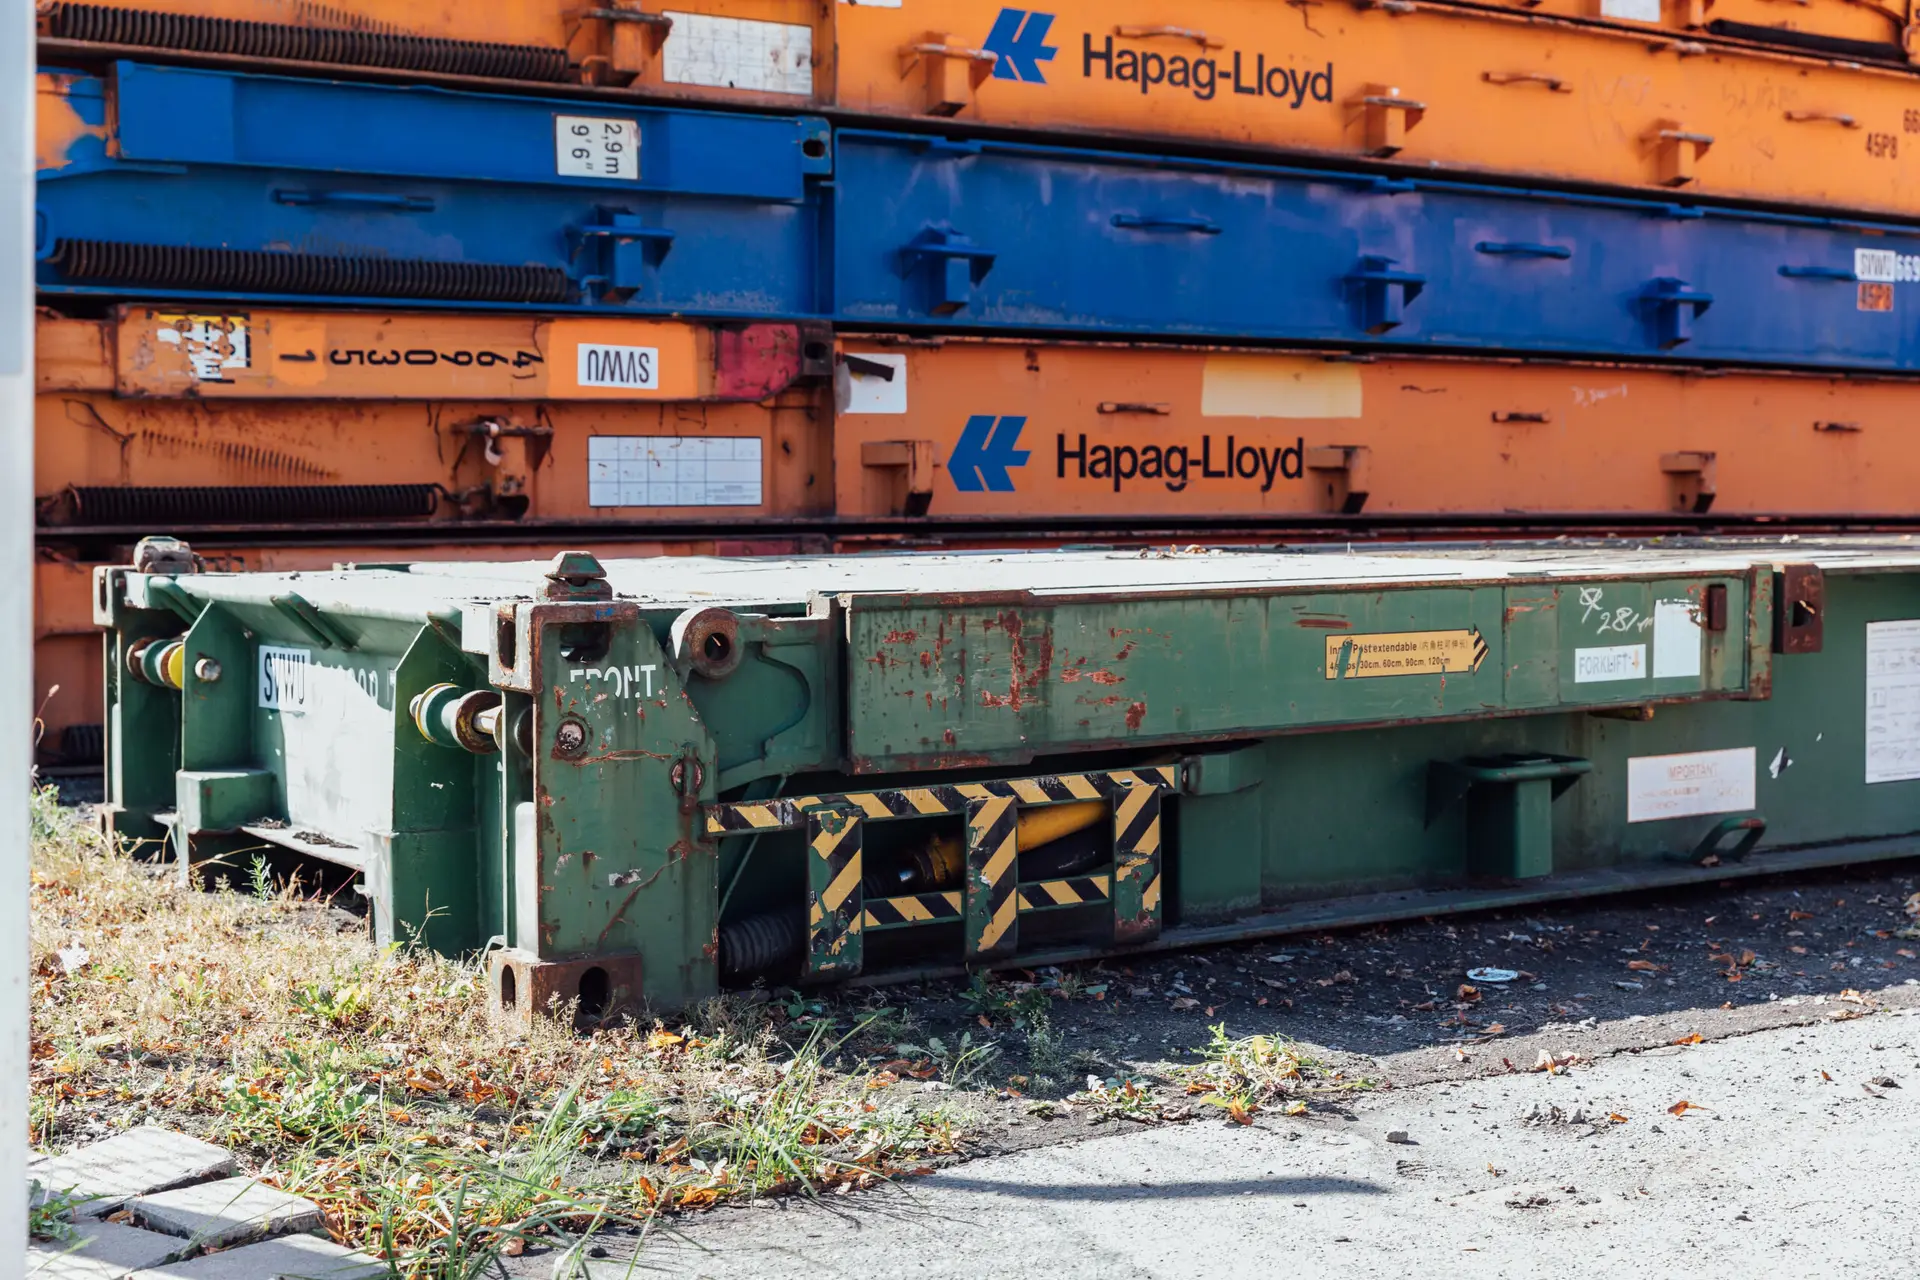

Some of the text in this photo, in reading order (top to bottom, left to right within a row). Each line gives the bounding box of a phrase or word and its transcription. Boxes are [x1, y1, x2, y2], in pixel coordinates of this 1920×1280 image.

[1083, 33, 1333, 109] Hapag-Lloyd
[588, 349, 650, 384] SVWU
[1057, 434, 1303, 492] Hapag-Lloyd
[1353, 644, 1371, 654] Pst
[1373, 641, 1417, 653] extendable
[1579, 653, 1628, 675] FORKLIFT
